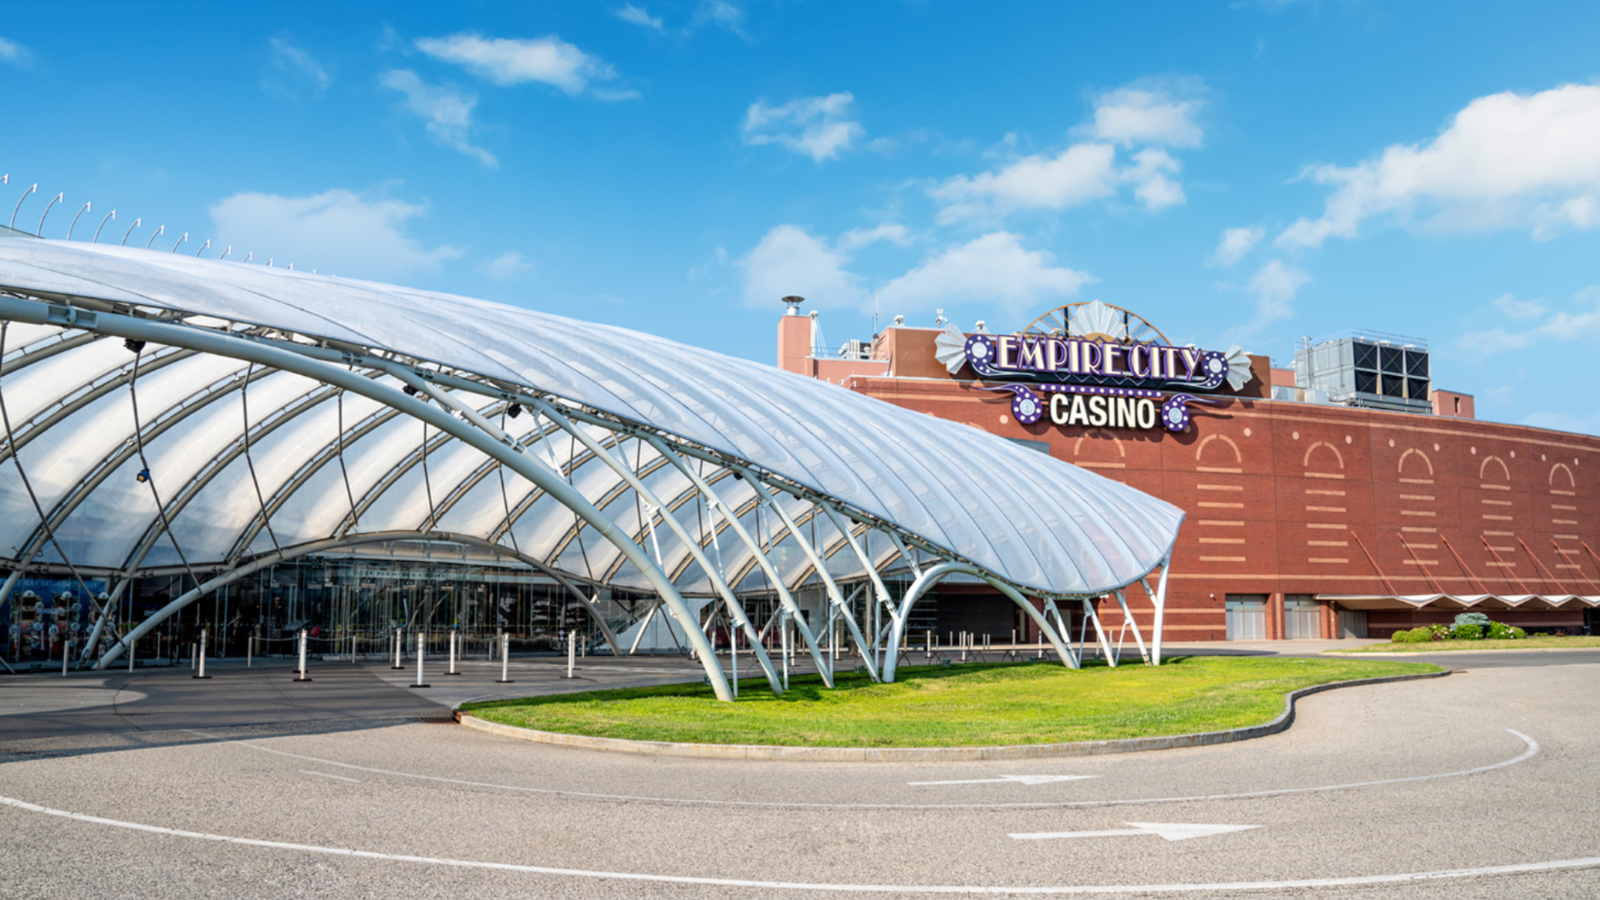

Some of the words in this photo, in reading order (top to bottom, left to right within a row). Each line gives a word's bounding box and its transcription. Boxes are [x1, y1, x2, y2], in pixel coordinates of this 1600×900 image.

[997, 335, 1122, 376] EMPIRE
[1129, 343, 1202, 382] CITY
[1050, 394, 1155, 428] CASINO
